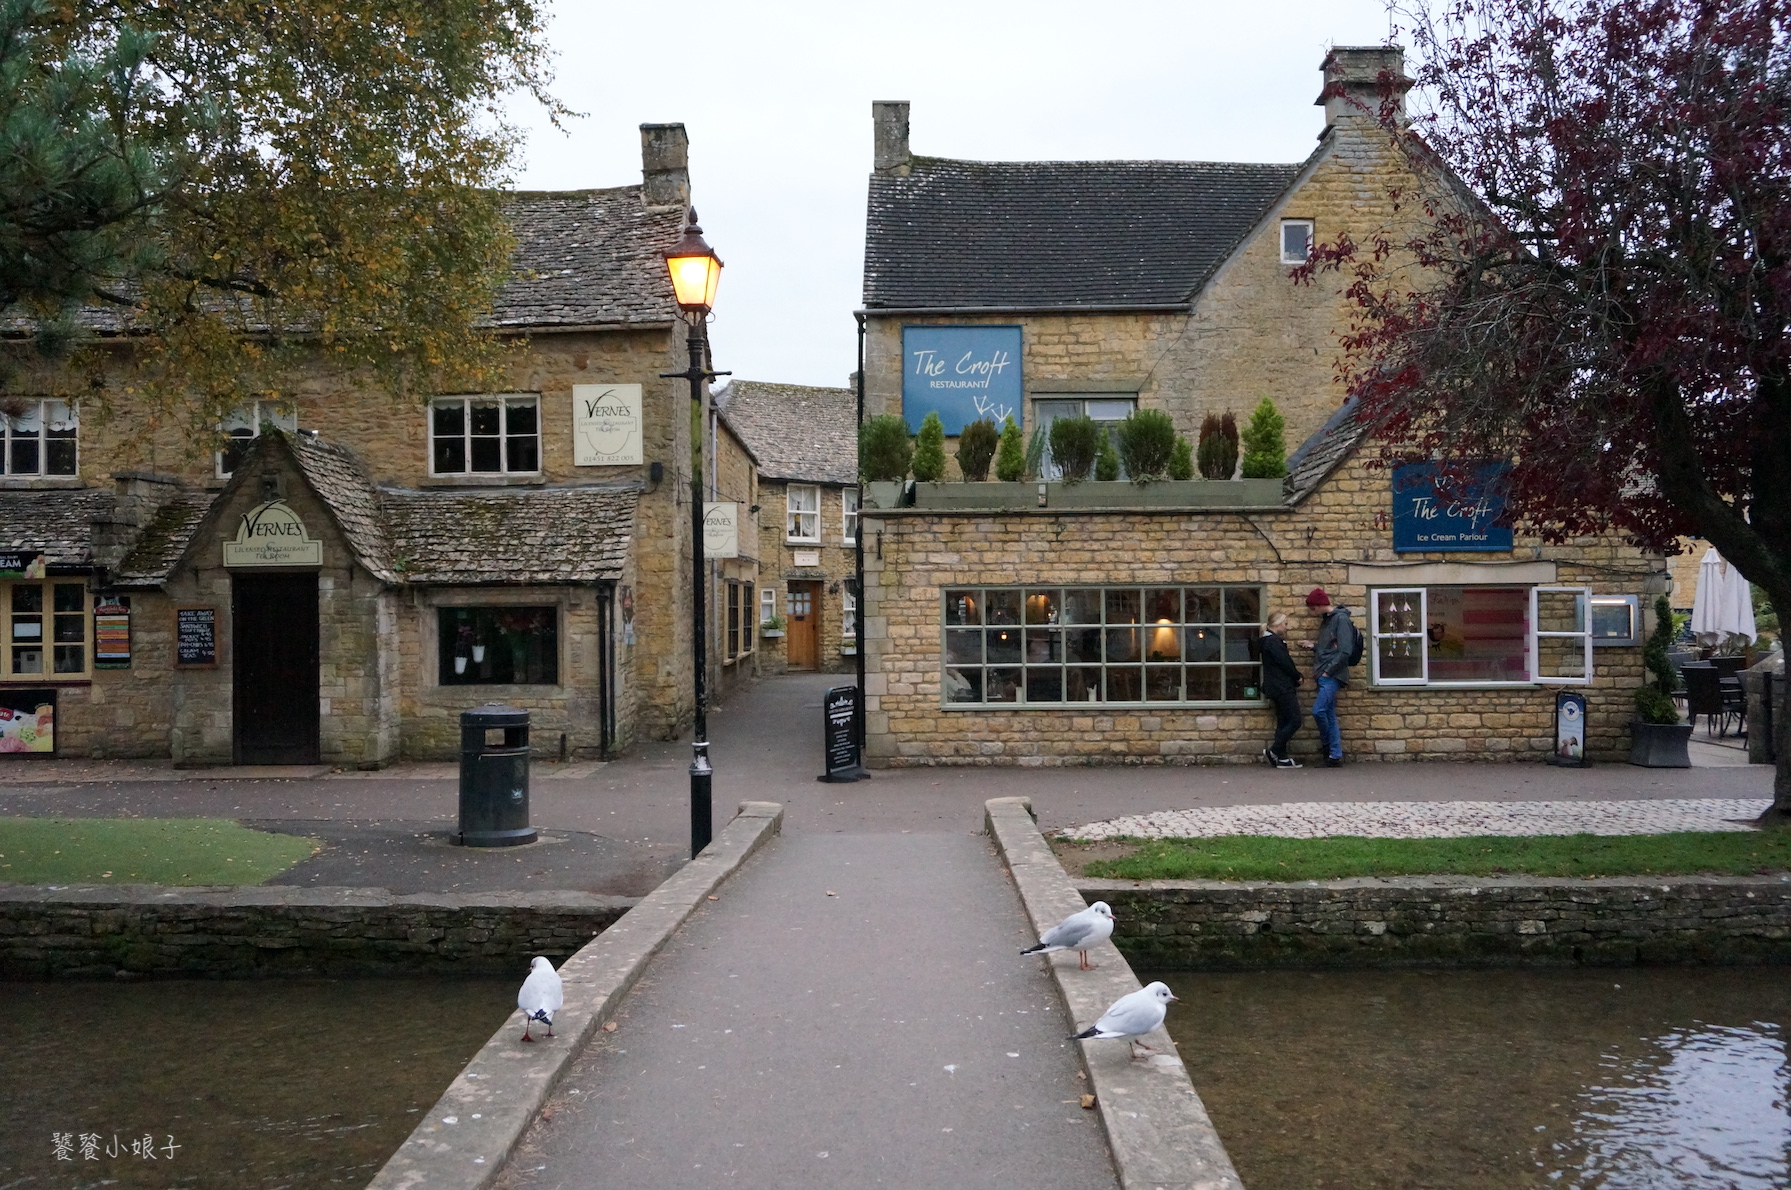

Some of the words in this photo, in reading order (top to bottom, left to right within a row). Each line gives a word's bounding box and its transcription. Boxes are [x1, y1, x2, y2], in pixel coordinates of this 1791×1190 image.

[913, 350, 945, 376] The
[955, 351, 1011, 388] Croft
[930, 380, 986, 389] RESTAURANT
[584, 388, 632, 418] VERNES
[242, 499, 303, 539] VERNES
[1412, 497, 1439, 520] The
[1446, 497, 1492, 529] Croft
[1417, 533, 1429, 541] Ice
[1431, 533, 1456, 541] Cream
[1459, 533, 1488, 541] Parlour
